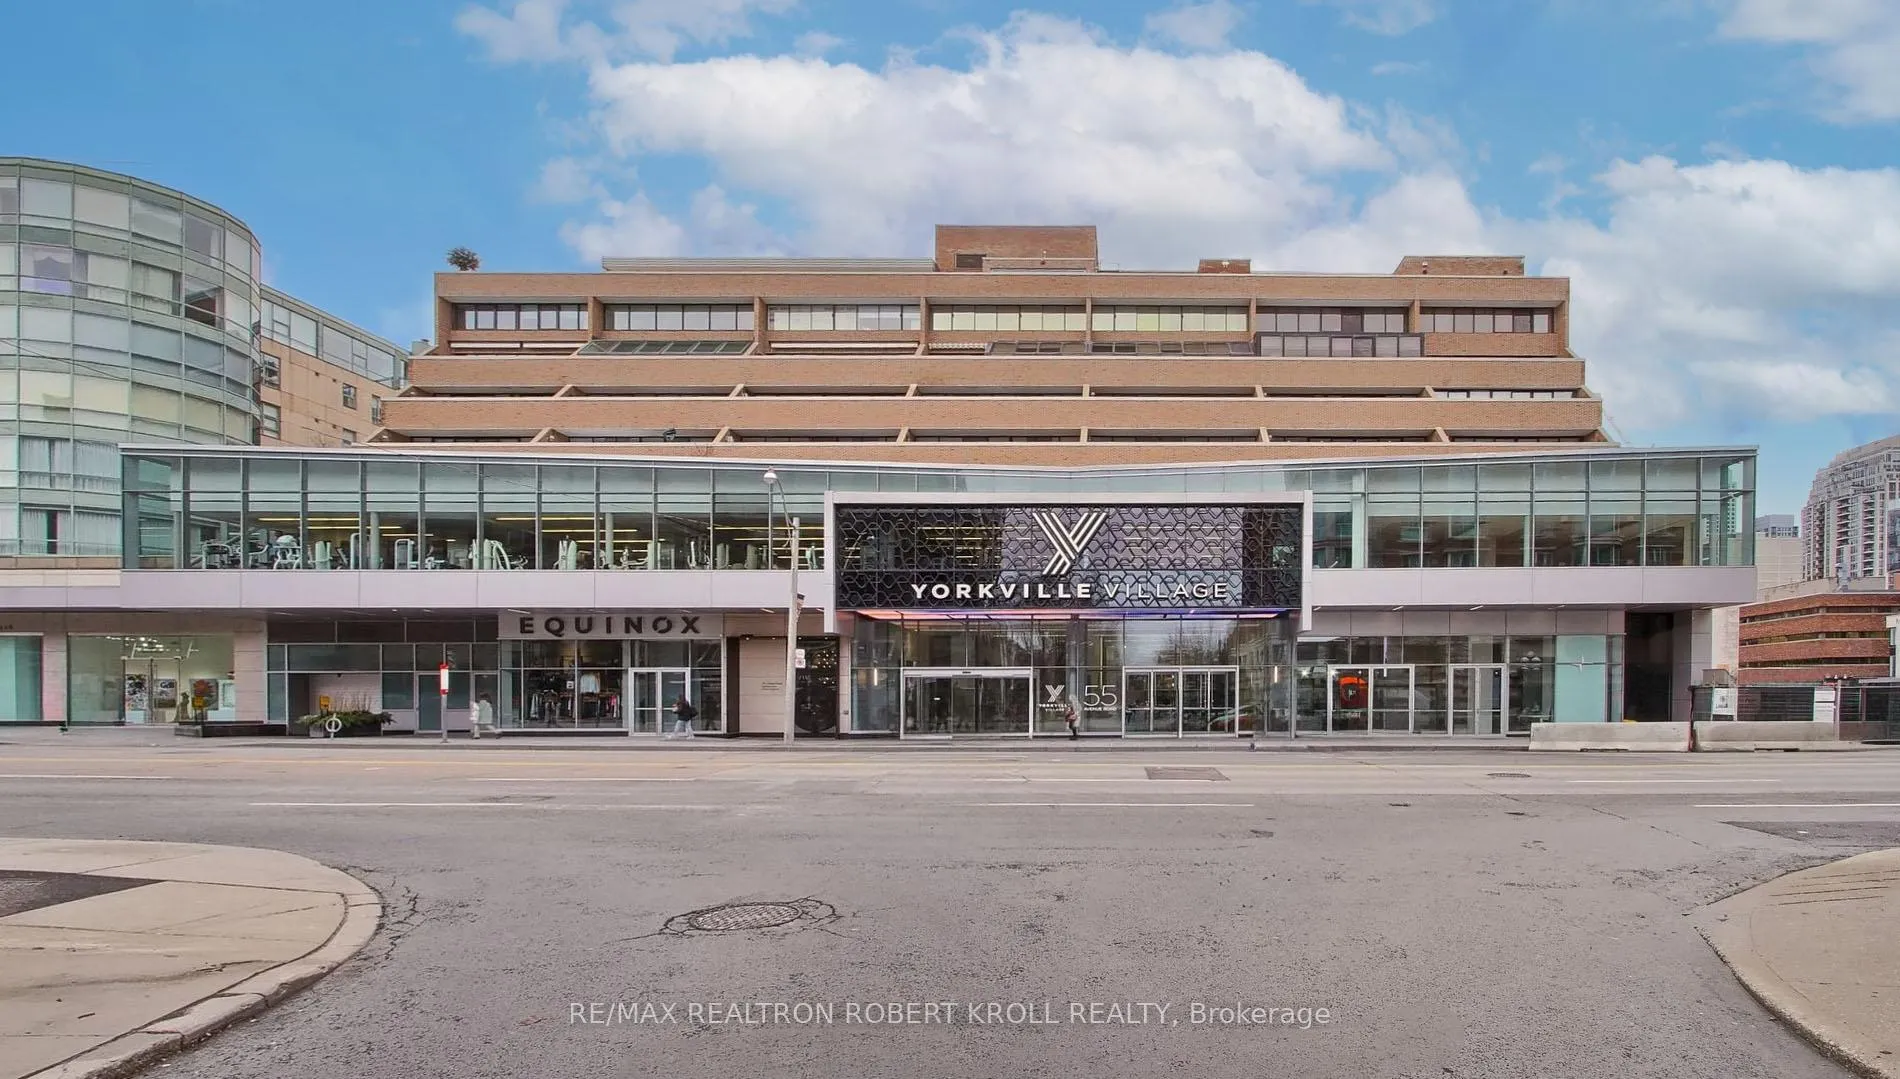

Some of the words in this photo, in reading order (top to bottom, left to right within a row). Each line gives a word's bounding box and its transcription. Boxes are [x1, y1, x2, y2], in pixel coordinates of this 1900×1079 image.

[911, 583, 1091, 599] YORKVILLE
[1104, 583, 1228, 599] VILLAGE
[519, 616, 700, 638] EQUINOX
[1083, 684, 1118, 707] 55
